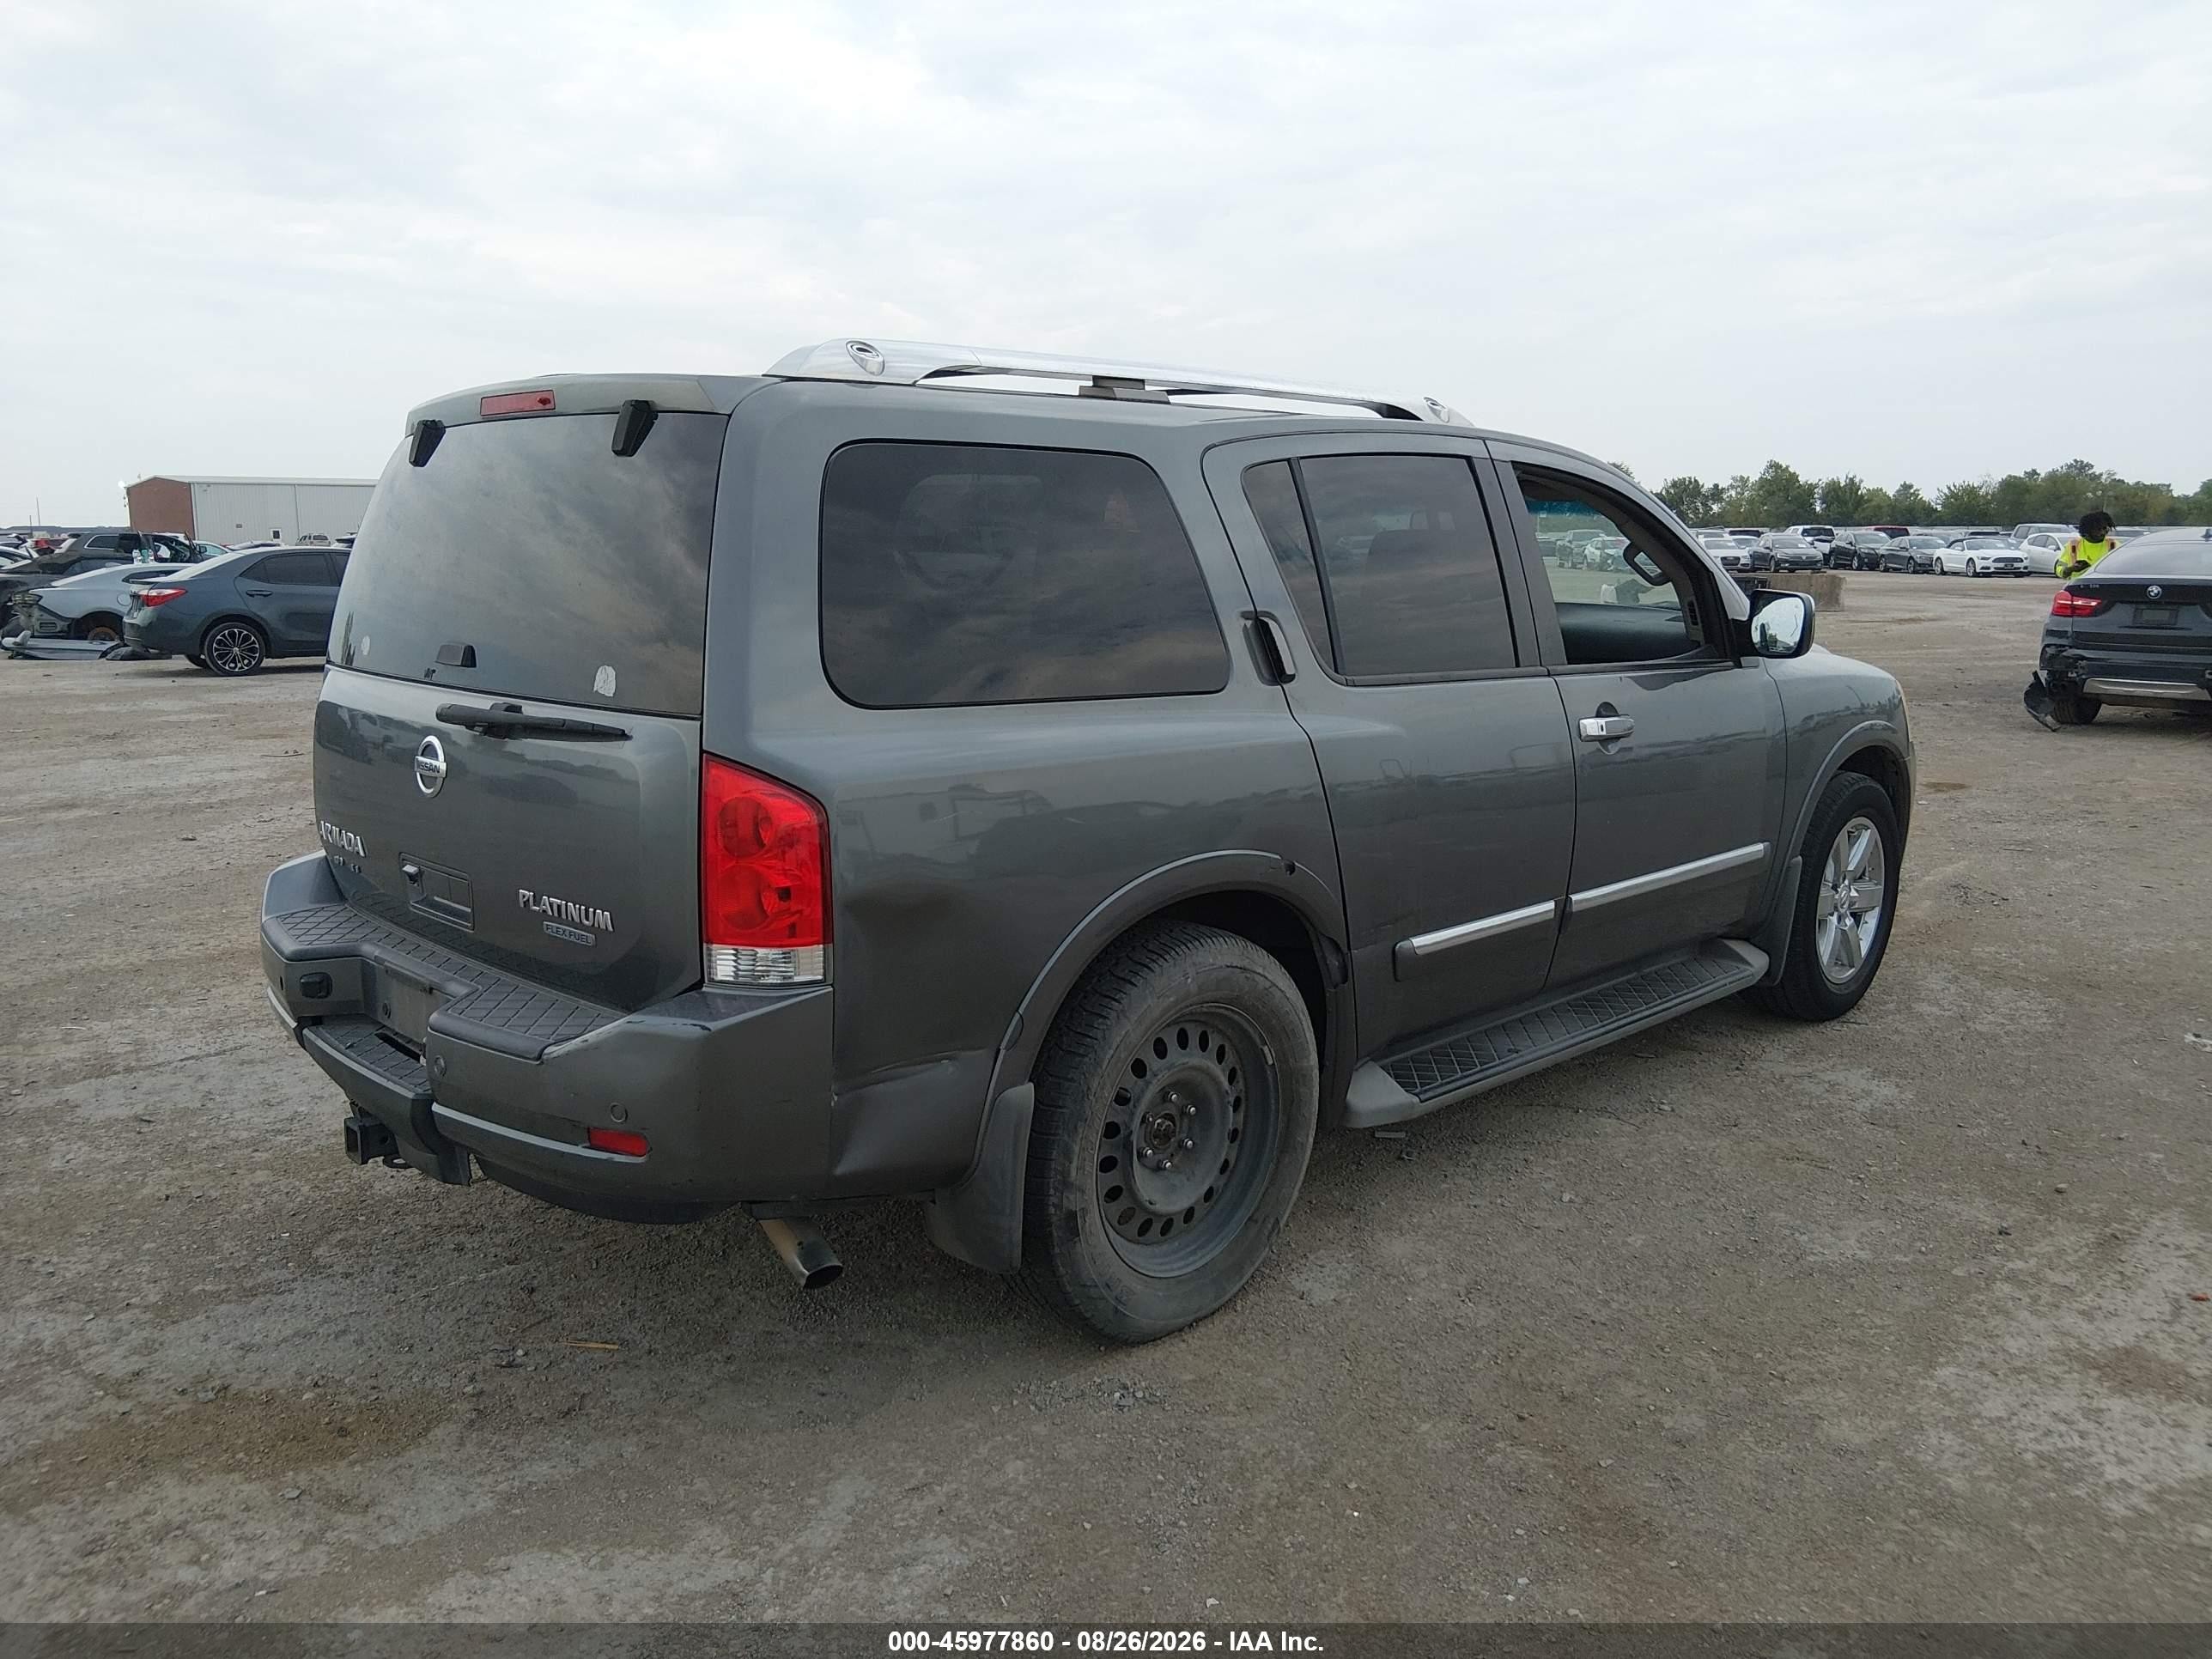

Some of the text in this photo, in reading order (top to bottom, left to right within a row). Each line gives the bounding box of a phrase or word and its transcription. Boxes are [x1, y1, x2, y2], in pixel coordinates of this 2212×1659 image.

[319, 820, 367, 857] ARMADA
[519, 889, 614, 932] PLATINUM
[546, 925, 592, 944] FLEX FUEL
